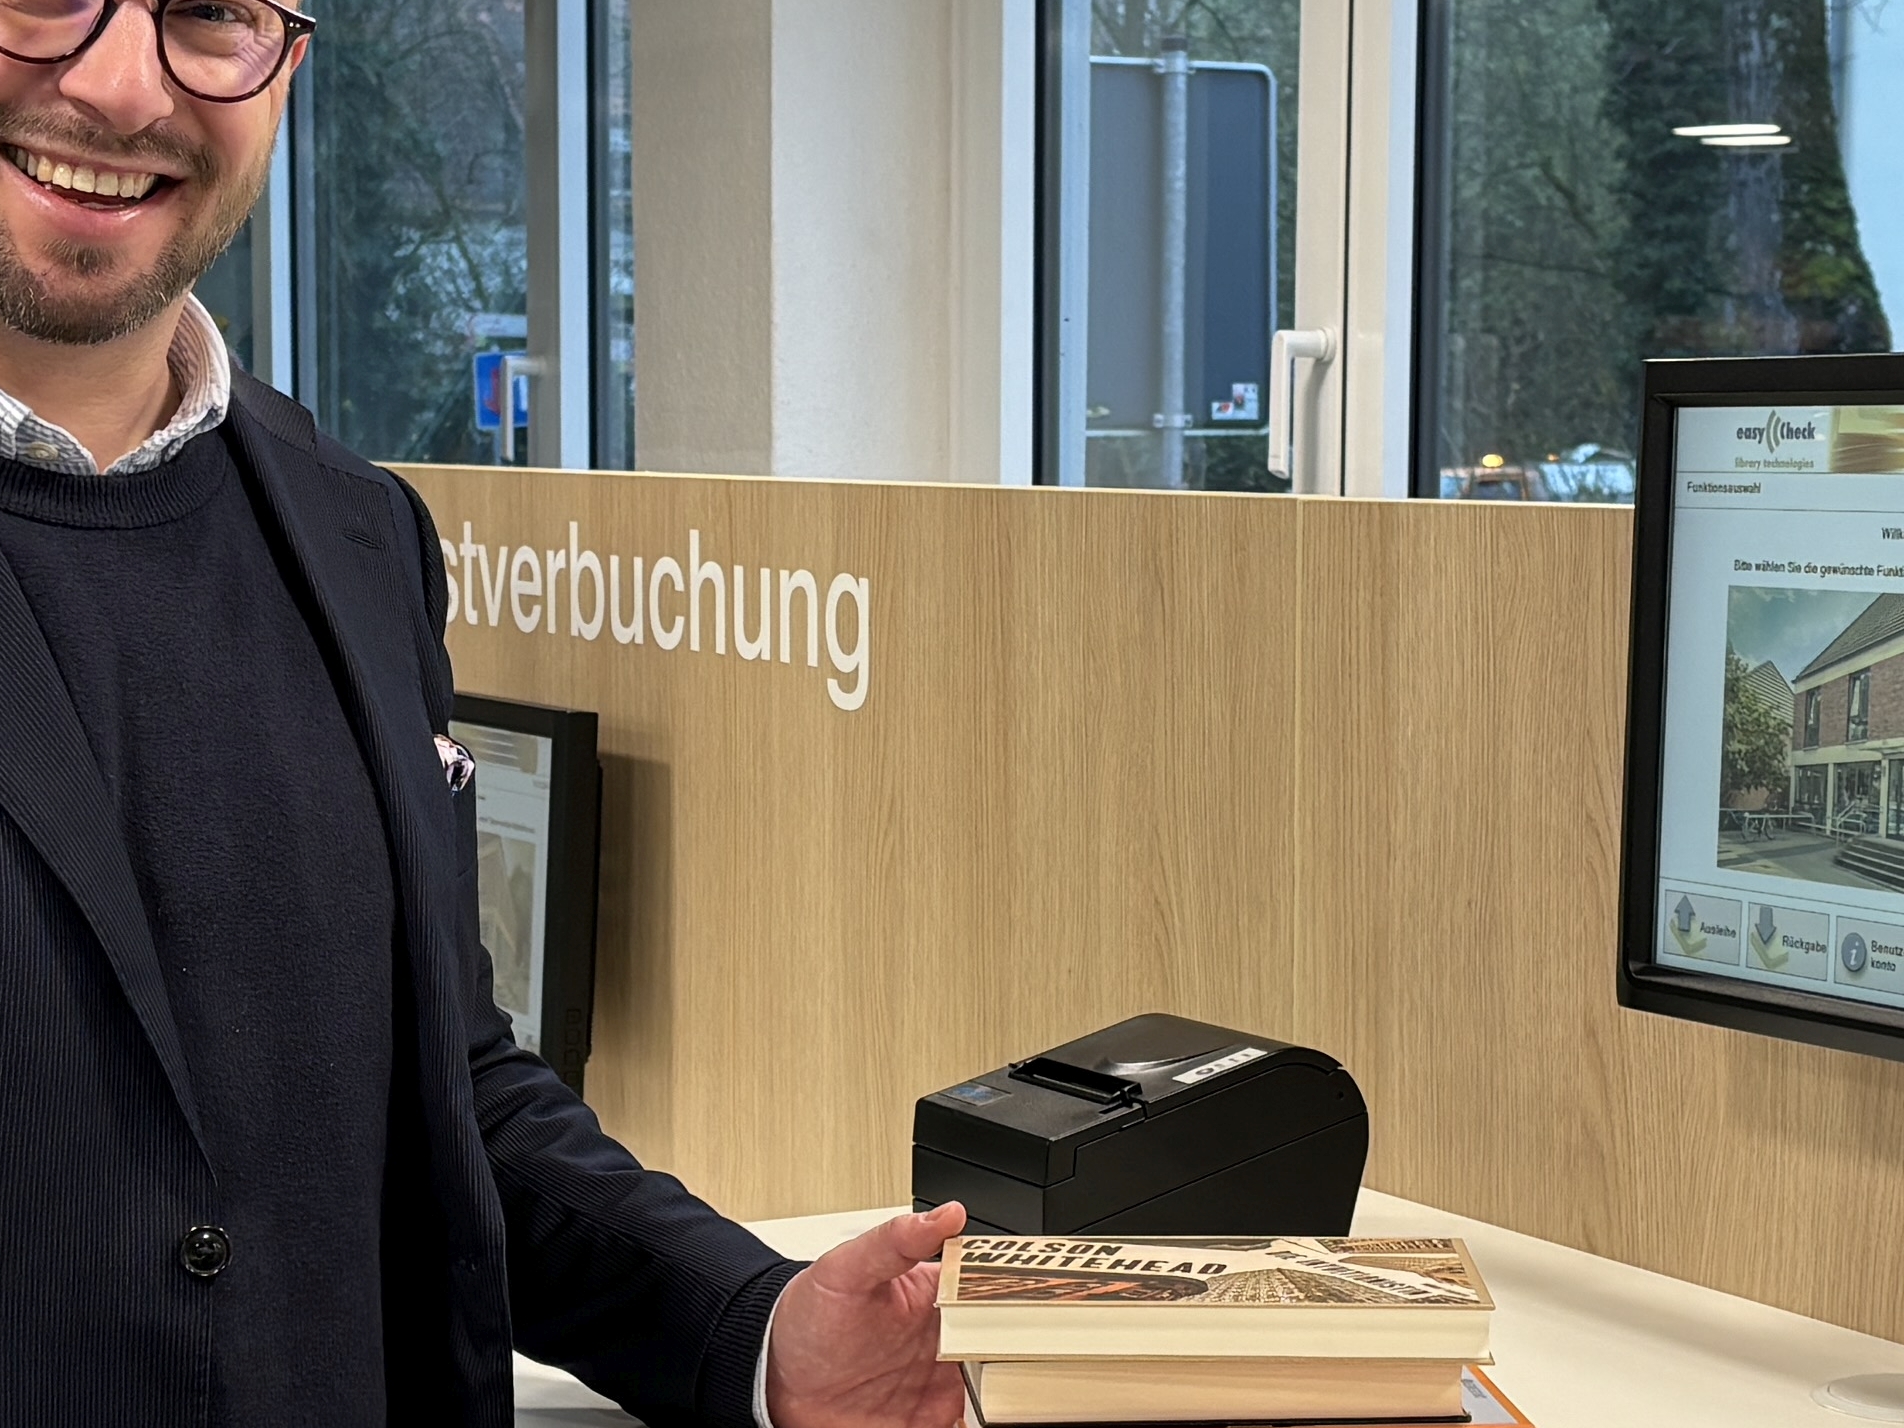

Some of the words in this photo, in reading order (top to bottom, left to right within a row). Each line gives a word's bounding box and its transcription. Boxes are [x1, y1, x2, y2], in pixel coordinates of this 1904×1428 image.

[1736, 424, 1766, 444] easy
[1735, 457, 1761, 470] library
[1687, 481, 1762, 494] Funktionsauswahl
[1733, 558, 1753, 572] Bitte
[1754, 559, 1786, 573] wählen
[1787, 560, 1802, 574] Sie
[1804, 561, 1818, 575] die
[1819, 562, 1875, 579] gewünschte
[1700, 921, 1737, 939] Ausleihe
[1782, 934, 1828, 955] Rückgabe
[1870, 957, 1897, 973] konto
[961, 1238, 1124, 1257] COLSON
[960, 1251, 1228, 1276] WHITEHEAD
